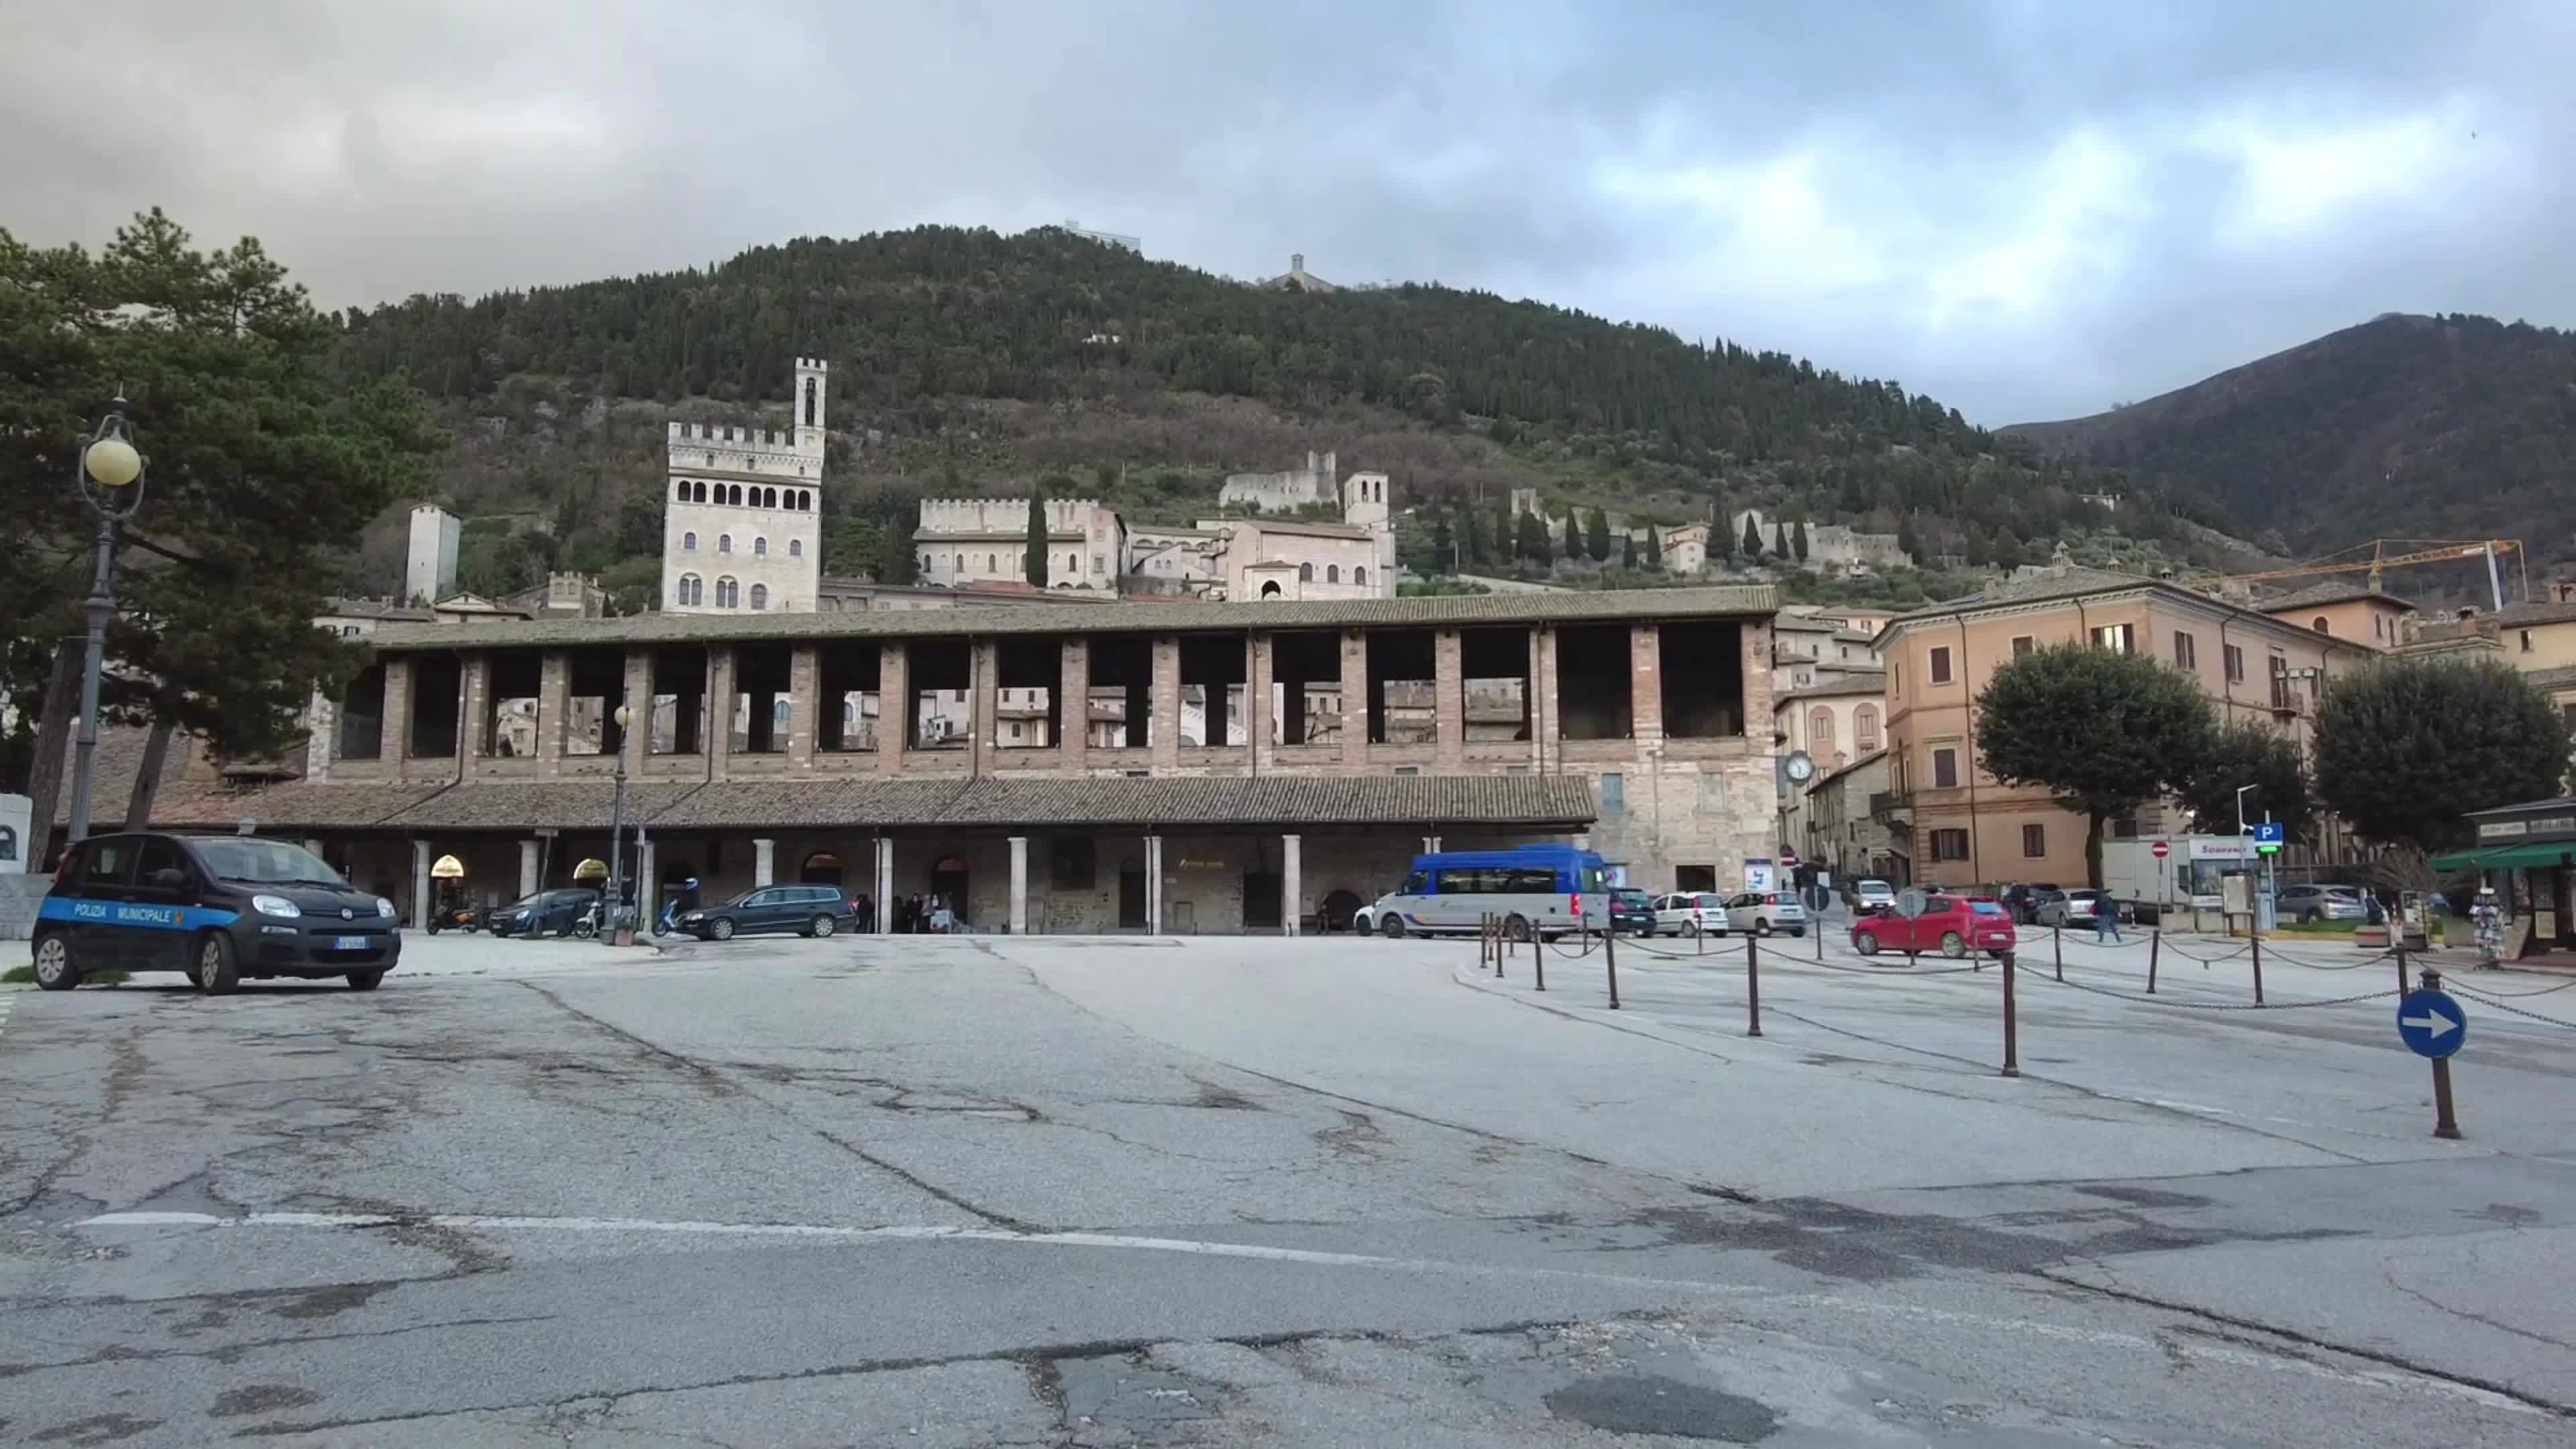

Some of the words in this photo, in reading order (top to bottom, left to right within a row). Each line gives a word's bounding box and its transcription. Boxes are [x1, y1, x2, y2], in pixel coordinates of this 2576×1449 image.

[2261, 826, 2273, 839] P
[74, 904, 107, 918] POLIZIA
[117, 906, 172, 922] MUNICIPALE
